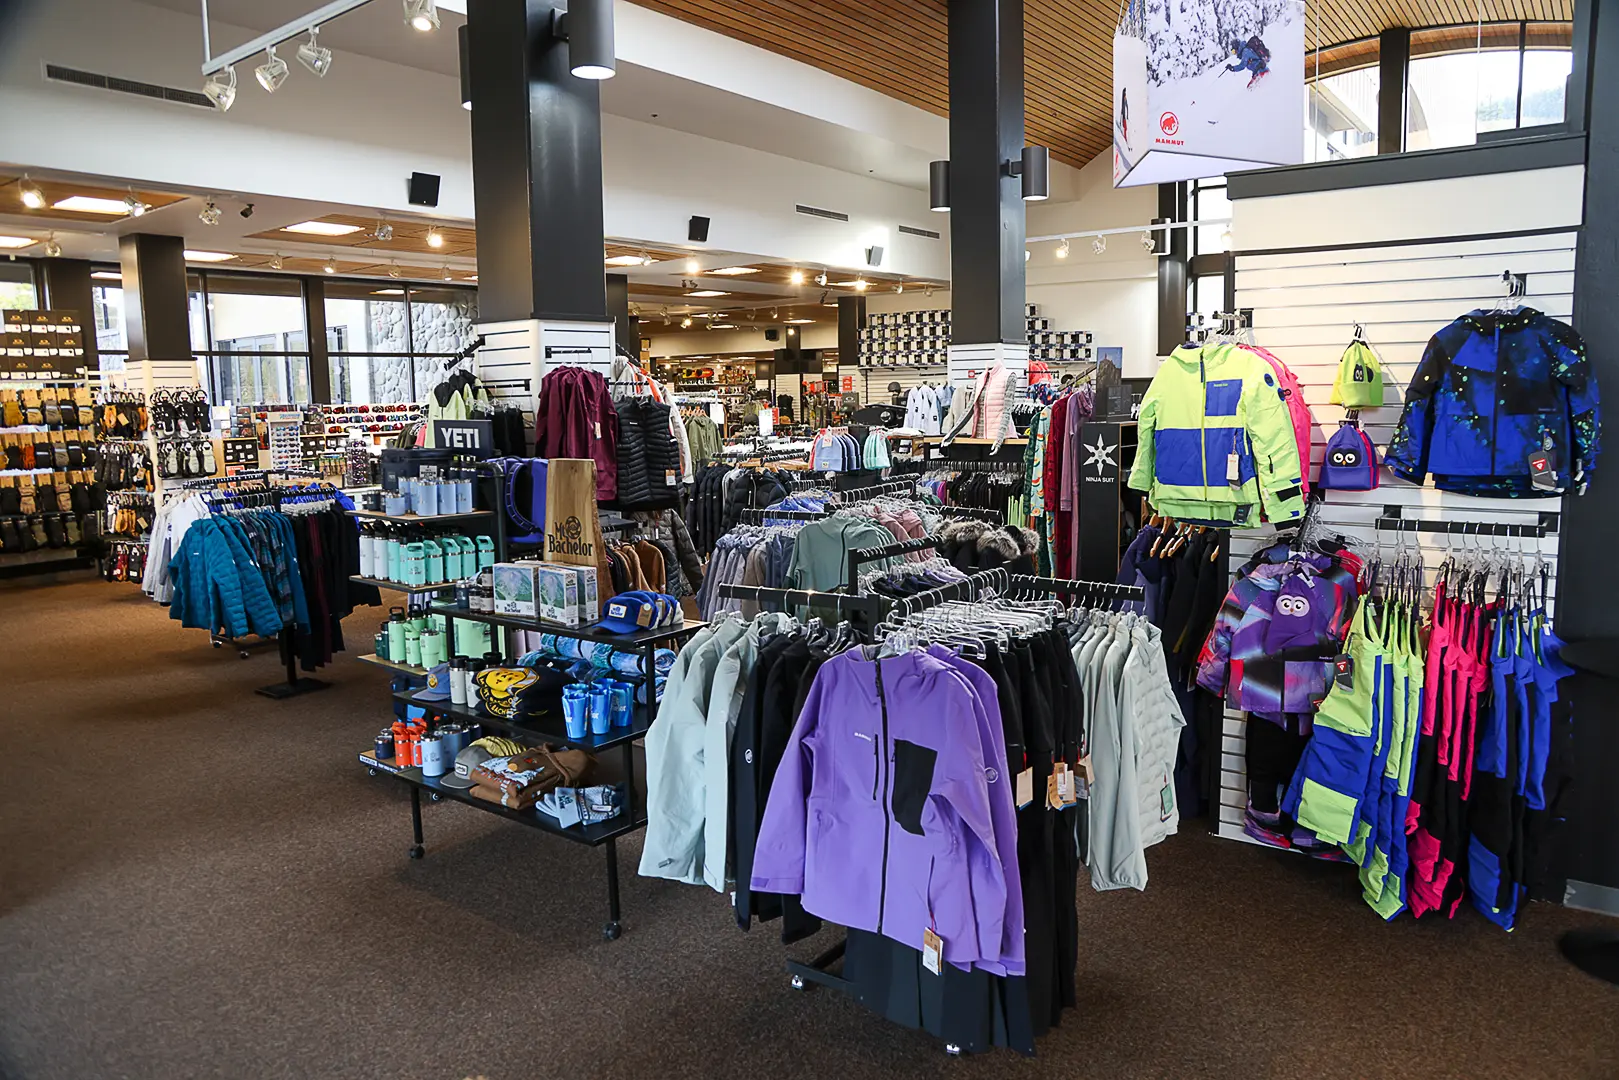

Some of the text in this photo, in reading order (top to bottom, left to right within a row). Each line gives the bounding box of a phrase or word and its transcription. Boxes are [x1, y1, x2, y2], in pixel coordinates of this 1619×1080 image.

[1155, 138, 1184, 146] MAMMUT
[440, 427, 480, 449] YETI
[547, 534, 593, 556] Bachelor
